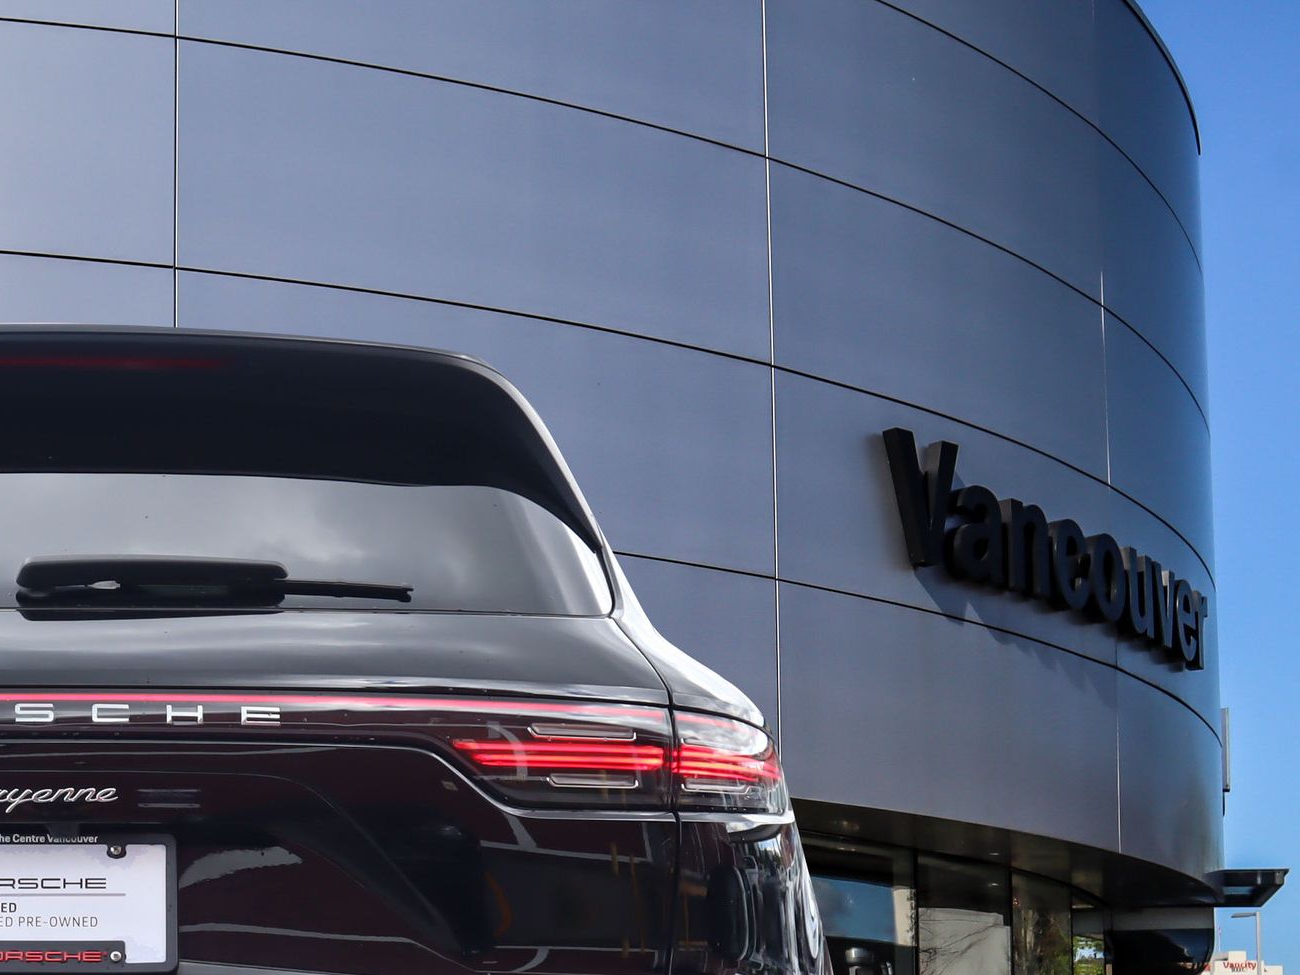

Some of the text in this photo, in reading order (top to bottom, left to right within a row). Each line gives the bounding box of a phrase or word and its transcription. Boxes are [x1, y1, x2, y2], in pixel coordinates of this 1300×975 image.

[882, 427, 1208, 671] Vancouver
[12, 834, 45, 843] Centre
[18, 916, 98, 928] PRE-OWNED
[1223, 961, 1257, 970] Vancity
